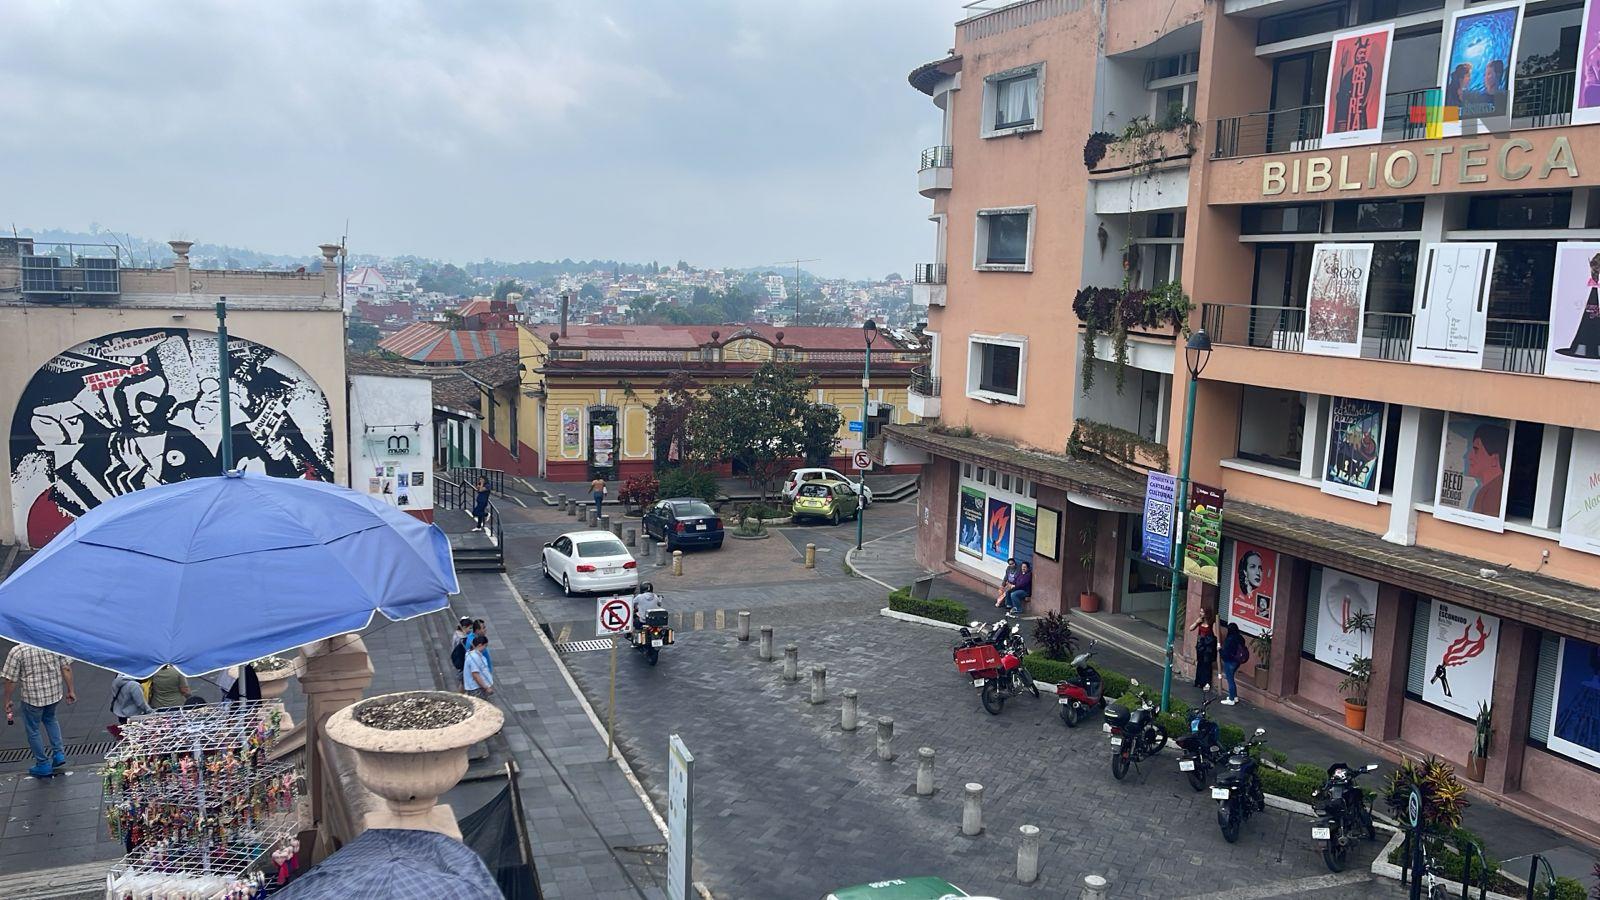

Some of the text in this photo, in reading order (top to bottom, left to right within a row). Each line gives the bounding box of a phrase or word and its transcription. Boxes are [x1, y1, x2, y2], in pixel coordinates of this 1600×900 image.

[1262, 137, 1578, 195] BIBLIOTECA
[102, 333, 166, 355] EL CAFE DE NADIE
[91, 379, 119, 391] ARCE
[1443, 472, 1463, 490] REED
[1149, 489, 1174, 499] CULTURAL
[1438, 611, 1467, 625] ESCONDIDO
